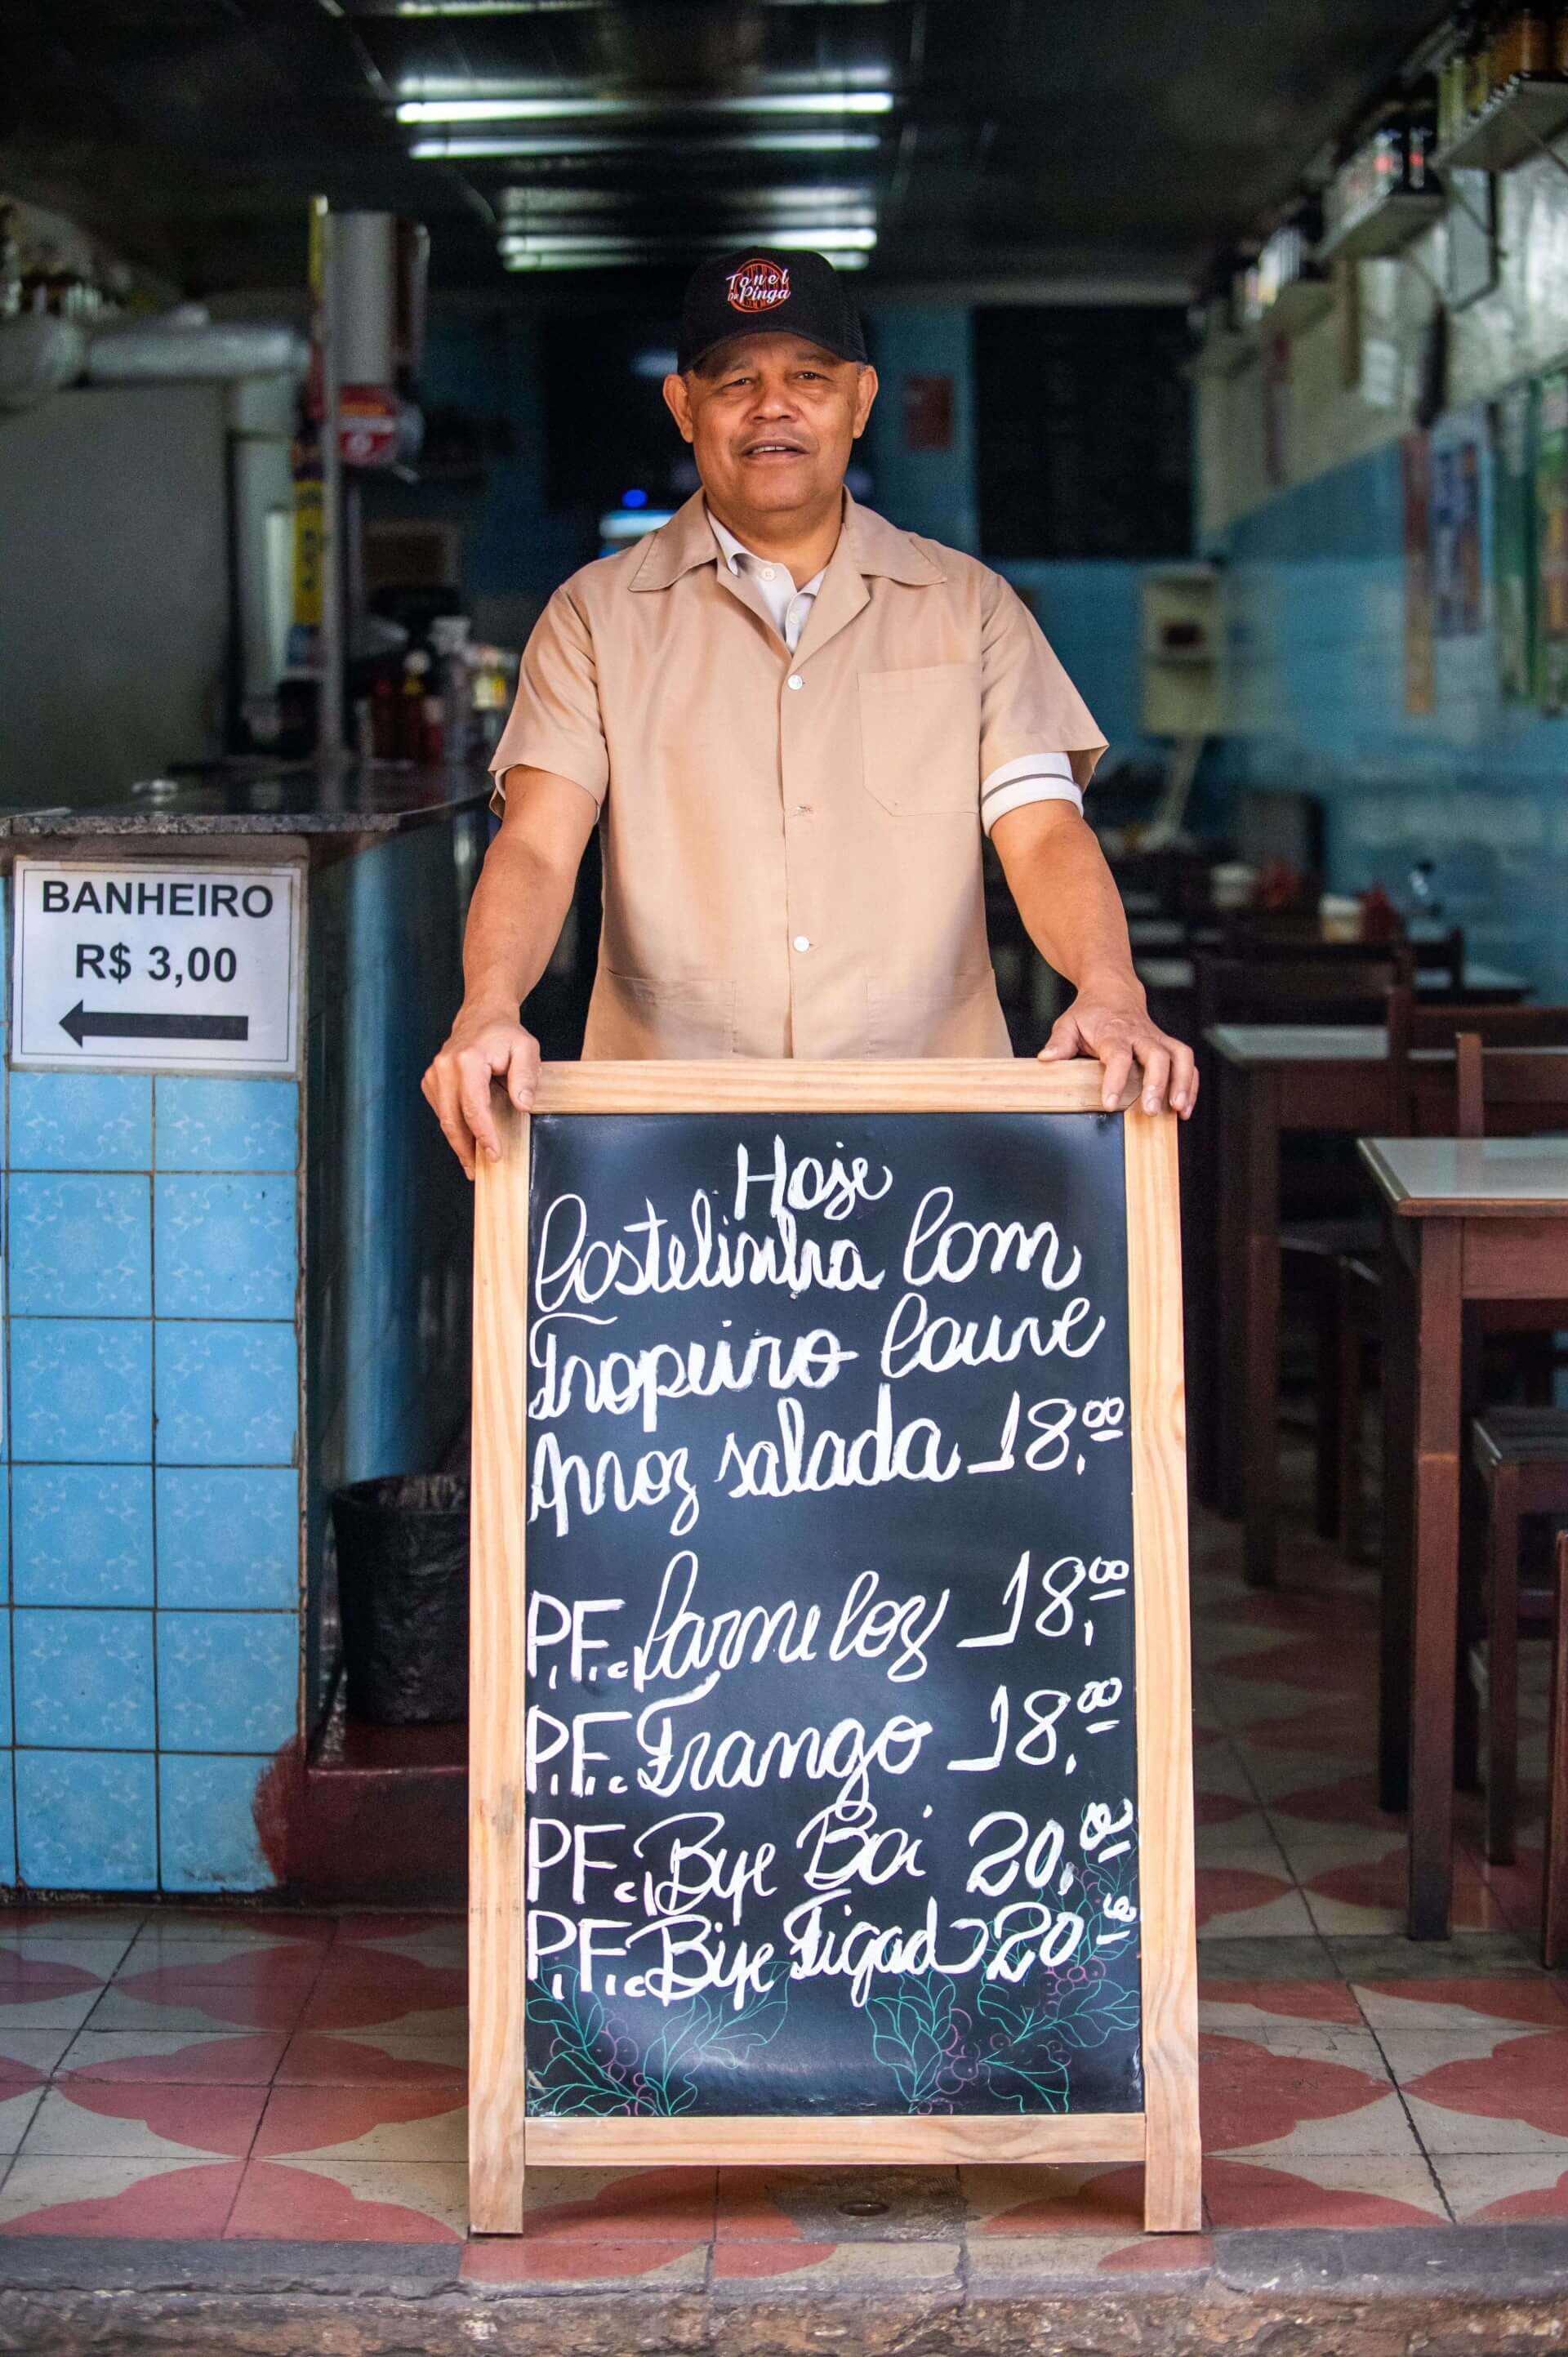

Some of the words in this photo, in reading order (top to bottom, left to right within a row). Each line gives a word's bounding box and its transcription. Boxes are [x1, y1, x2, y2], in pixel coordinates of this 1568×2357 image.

[725, 269, 790, 290] Tonel
[738, 286, 791, 303] Pinga
[42, 880, 274, 918] BANHEIRO
[76, 942, 131, 983] R$
[148, 946, 237, 988] 3,00
[734, 1134, 893, 1221] Hoje
[714, 1383, 961, 1498] salada
